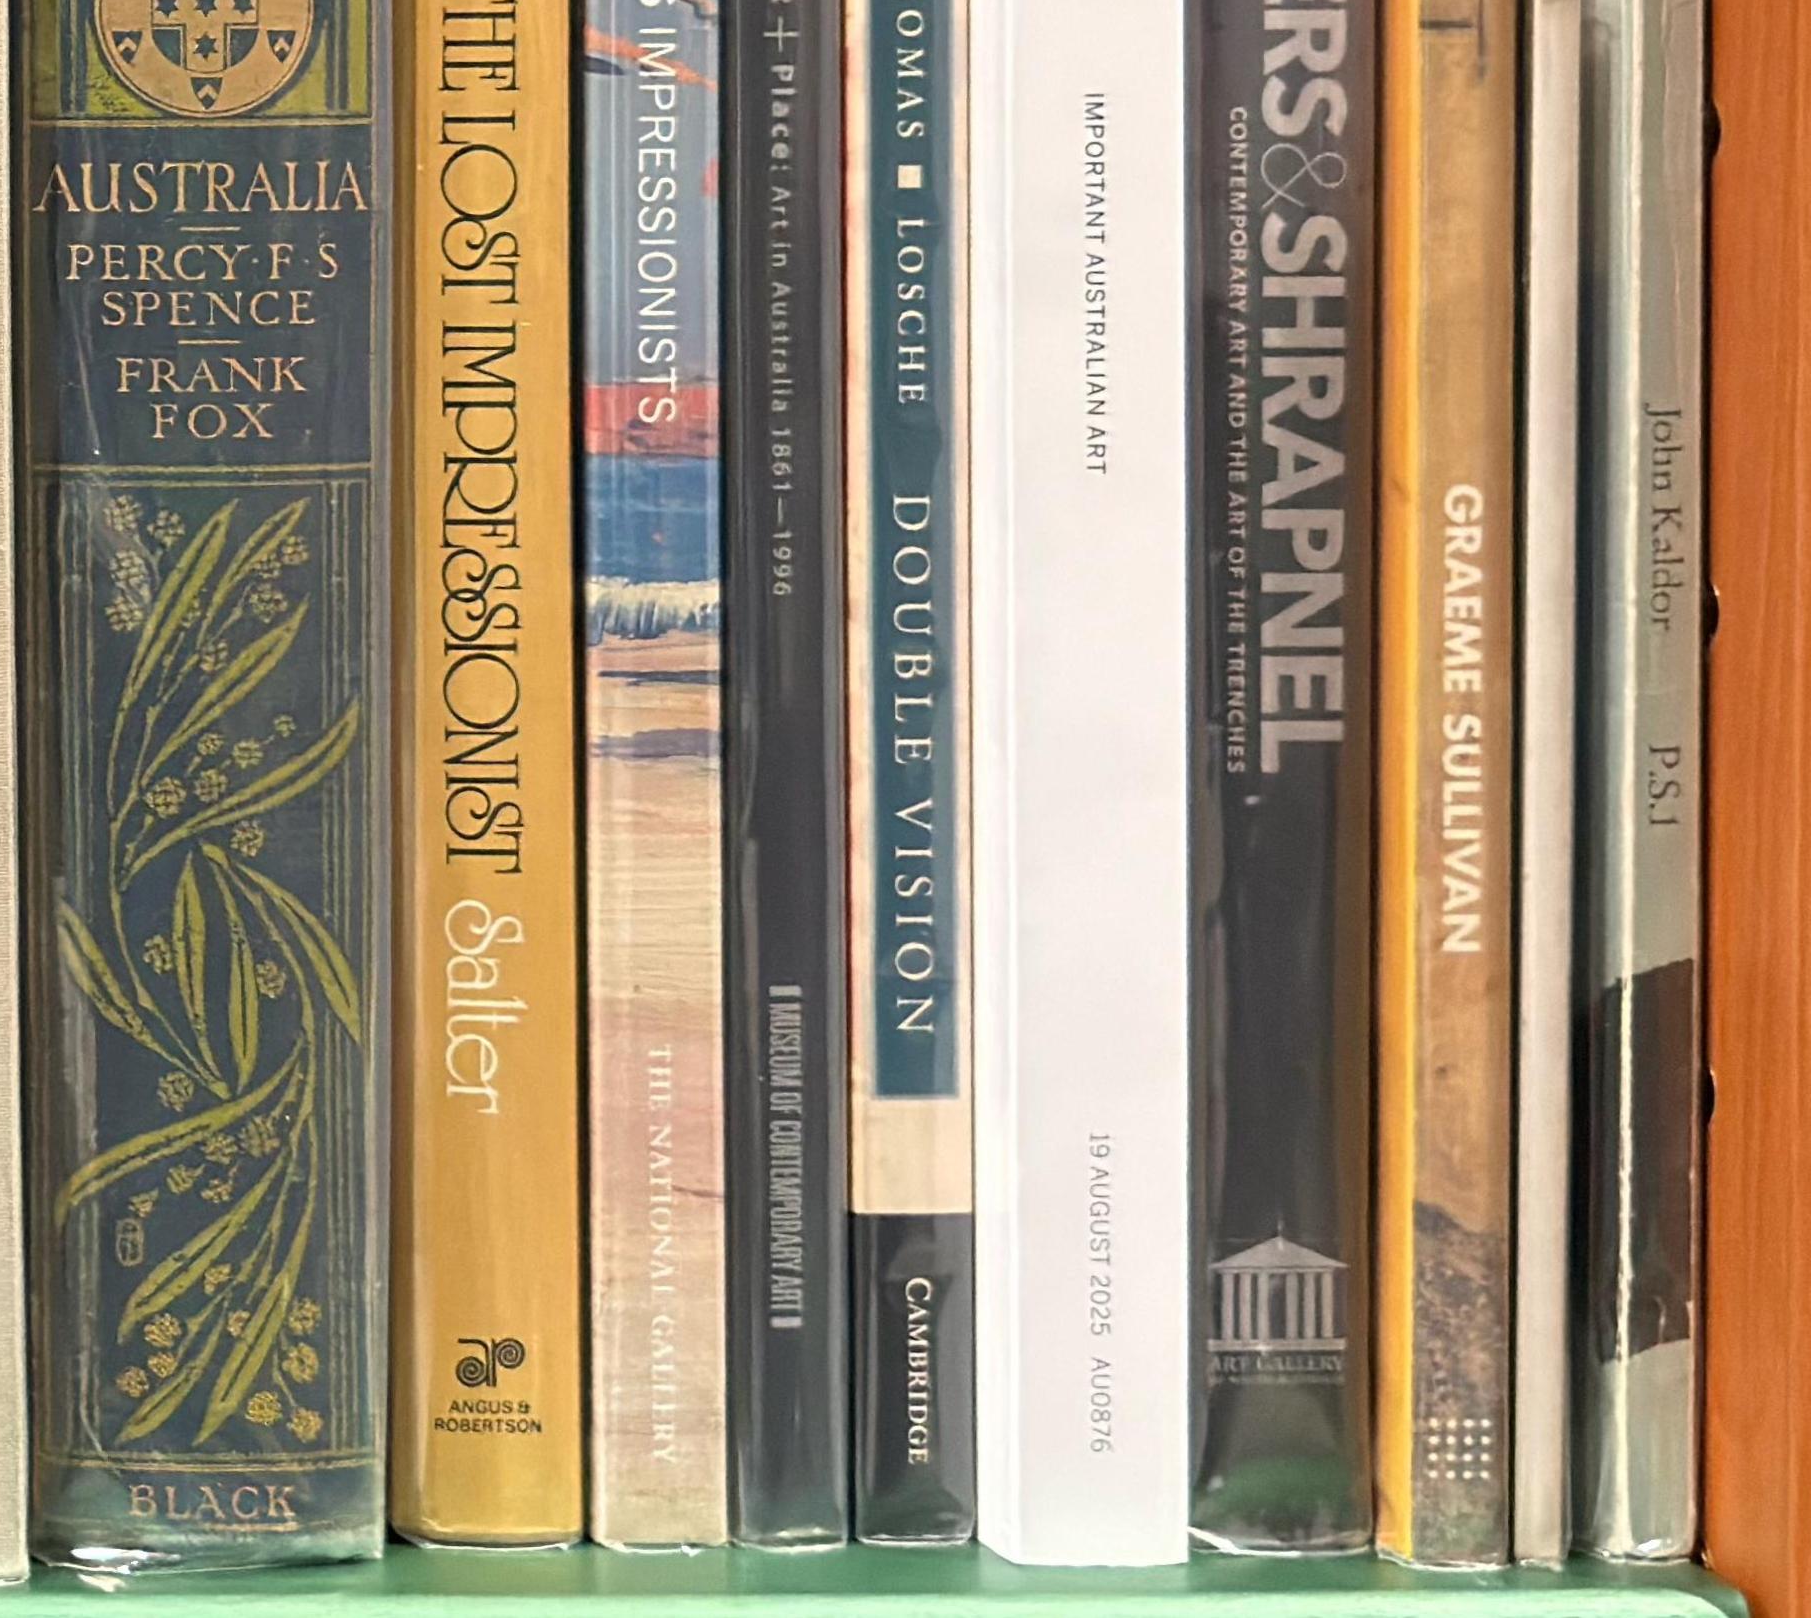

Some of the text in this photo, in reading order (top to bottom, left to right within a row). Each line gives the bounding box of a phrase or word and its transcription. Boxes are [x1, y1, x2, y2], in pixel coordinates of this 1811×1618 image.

[33, 160, 370, 214] AUSTRALIA
[438, 116, 518, 306] LOST
[636, 25, 677, 423] IMPRESSIONISTS
[769, 185, 791, 231] Art
[1084, 92, 1106, 244] IMPORTANT
[101, 290, 317, 326] SPENCE
[117, 358, 307, 393] FRANK
[769, 281, 794, 414] Australia
[896, 216, 926, 405] LOSCHE
[1085, 253, 1106, 417] AUSTRALIAN
[151, 403, 274, 440] FOX
[1085, 424, 1107, 475] ART
[1227, 105, 1249, 774] CONTEMPORARY ART AND THE ART OF THE TRENCHES
[1443, 482, 1483, 694] GRAEME
[1644, 403, 1684, 631] John Kaldor
[439, 320, 526, 875] IMPRESSIONIST
[891, 493, 935, 764] DOUBLE
[1441, 714, 1483, 953] SULLIVAN
[894, 795, 935, 1035] VISION
[445, 899, 529, 1114] Salter
[1089, 1132, 1110, 1159] 19
[1089, 1167, 1111, 1266] AUGUST
[904, 1278, 929, 1465] CAMBRIDGE
[1090, 1275, 1112, 1337] 2025
[435, 1418, 542, 1433] ROBERTSON
[449, 1400, 513, 1414] ANGUS
[1090, 1357, 1113, 1454] AU0876
[128, 1485, 297, 1518] BLACK
